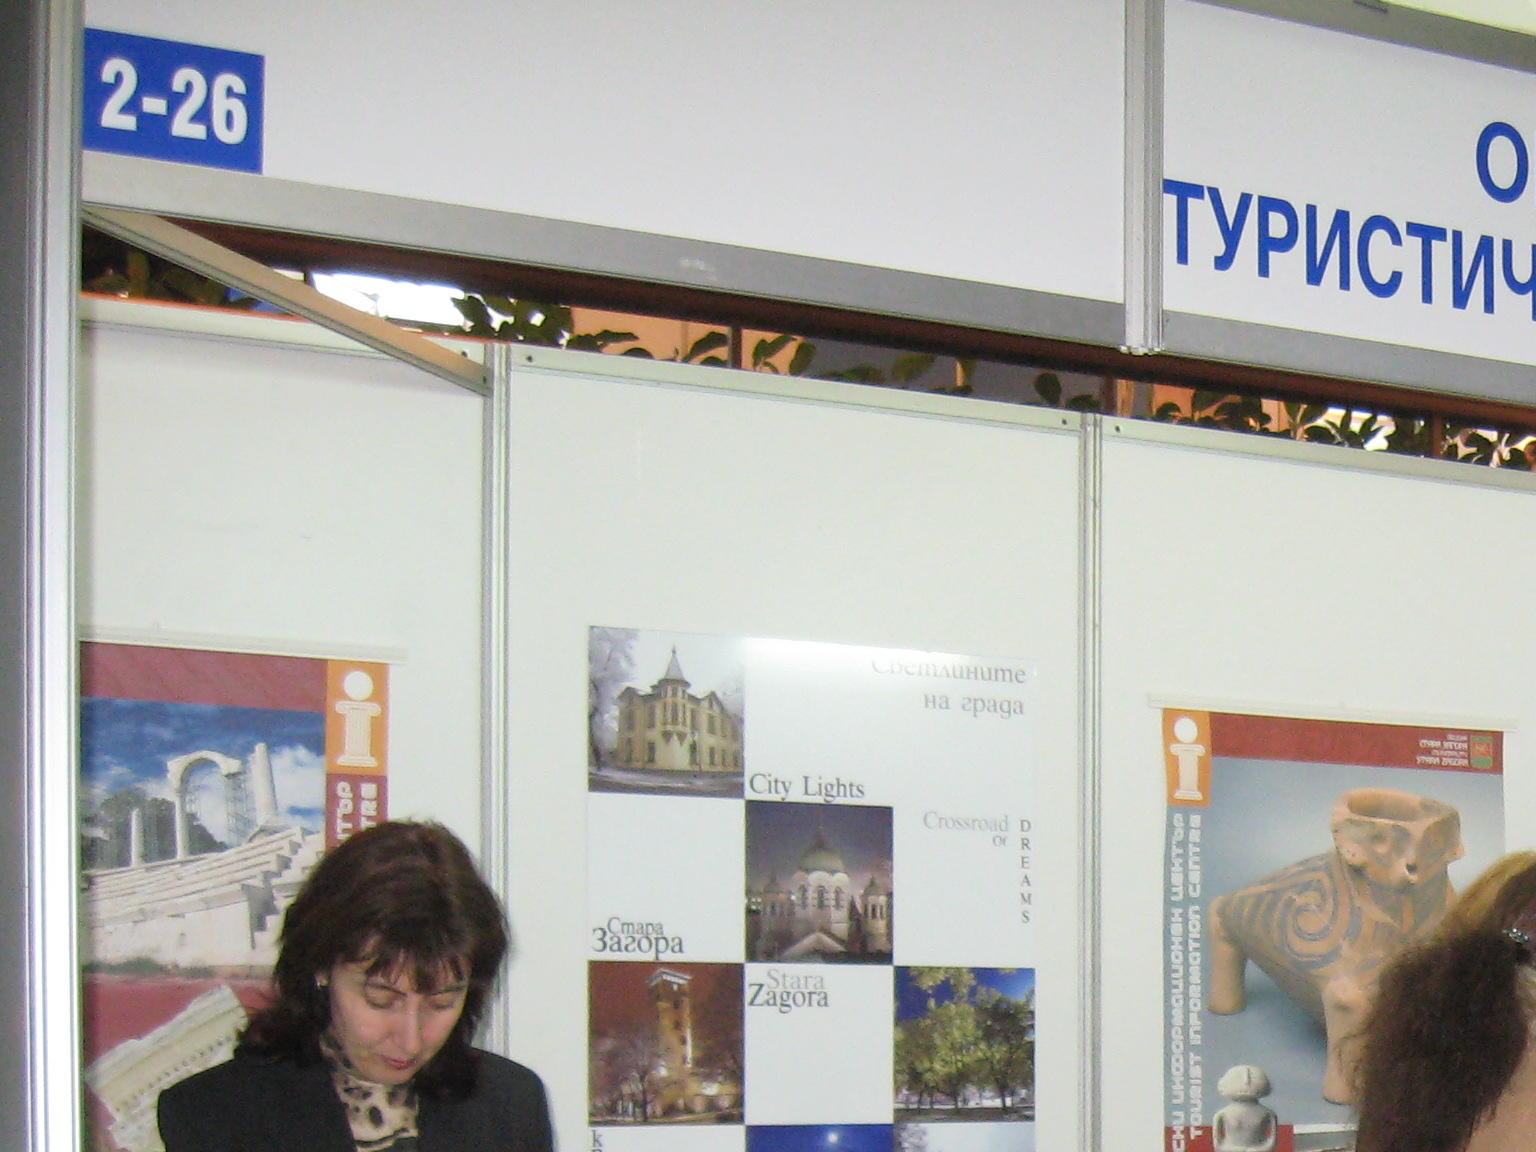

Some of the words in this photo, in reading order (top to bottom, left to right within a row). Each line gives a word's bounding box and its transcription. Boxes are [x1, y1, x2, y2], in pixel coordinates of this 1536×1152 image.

[100, 58, 248, 145] 2-26
[749, 772, 793, 801] City
[802, 774, 865, 803] Lights
[922, 810, 1009, 833] Crossroad
[1019, 818, 1033, 924] DREAMS
[606, 916, 664, 936] Стара
[592, 927, 685, 961] Загора
[766, 968, 824, 990] Stara
[748, 983, 830, 1014] Zagora
